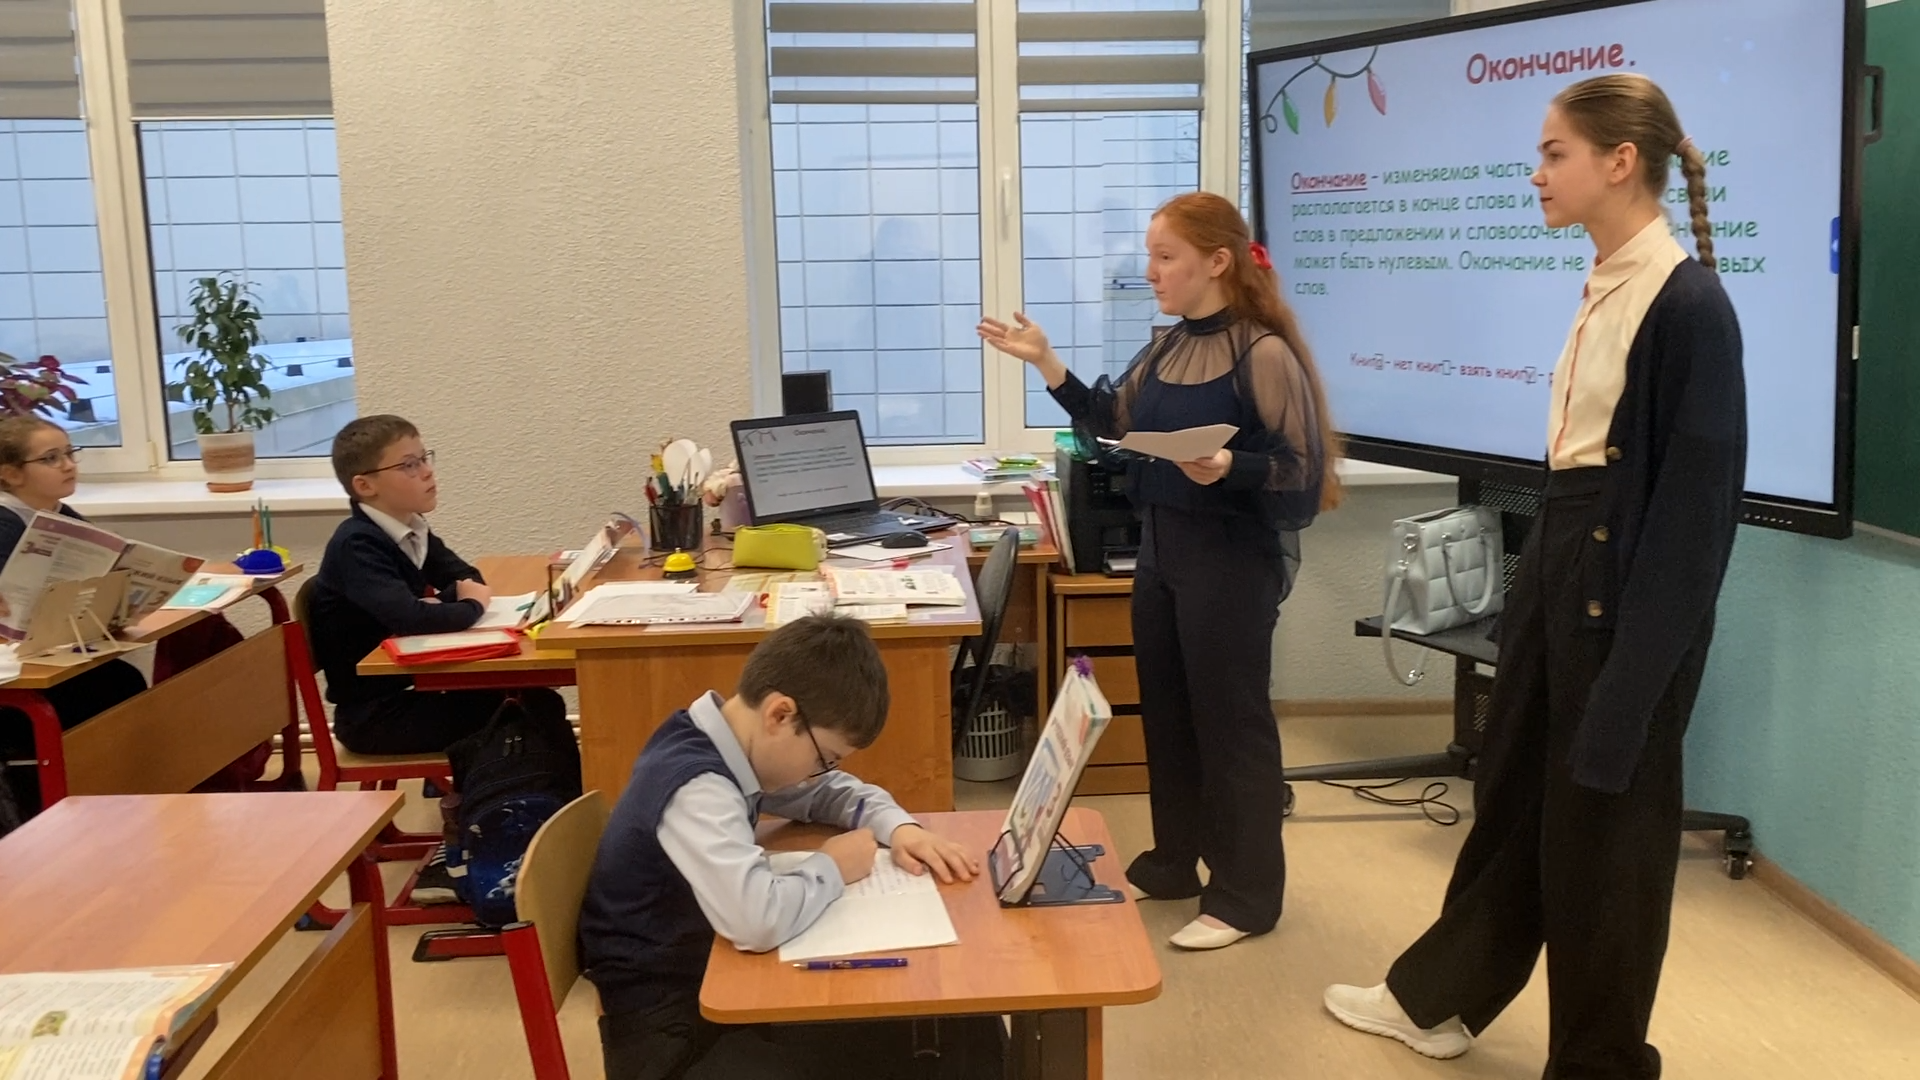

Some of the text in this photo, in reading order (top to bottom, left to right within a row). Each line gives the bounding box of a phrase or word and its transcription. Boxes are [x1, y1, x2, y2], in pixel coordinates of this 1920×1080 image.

[1466, 43, 1636, 84] Окончание.
[1291, 172, 1367, 192] Окончание
[1383, 163, 1480, 184] изменяемая
[1485, 161, 1534, 179] часть
[1292, 198, 1395, 222] располагается
[1400, 198, 1407, 213] в
[1413, 195, 1460, 213] конце
[1465, 193, 1516, 211] слова
[1522, 193, 1534, 208] и
[1293, 227, 1325, 244] слов
[1328, 228, 1335, 243] в
[1340, 225, 1445, 248] предложении
[1450, 225, 1461, 241] и
[1293, 254, 1336, 270] может
[1340, 252, 1375, 270] быть
[1378, 254, 1453, 275] нулевым.
[1459, 250, 1557, 271] Окончание
[1562, 255, 1586, 271] не
[1295, 281, 1329, 297] слов.
[1394, 359, 1413, 371] нет
[1460, 365, 1493, 378] взять
